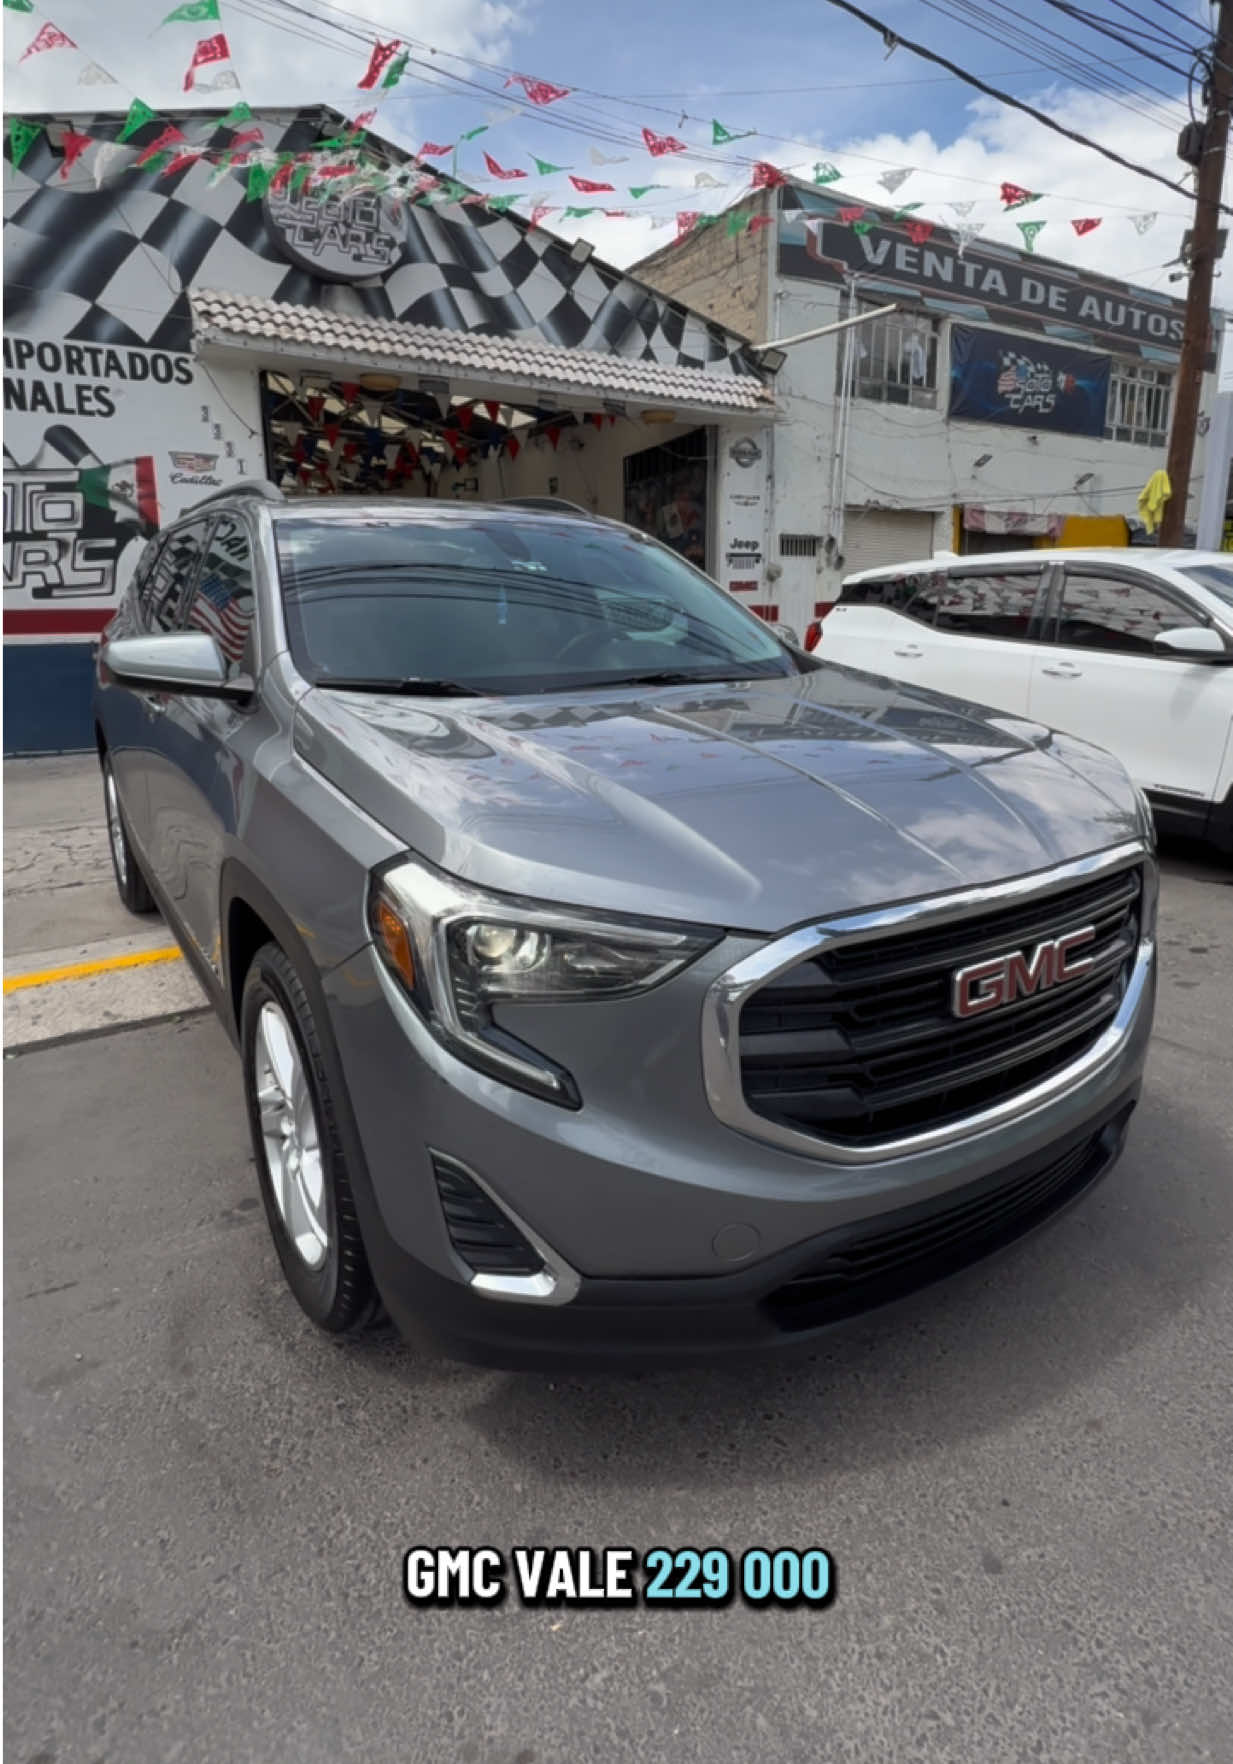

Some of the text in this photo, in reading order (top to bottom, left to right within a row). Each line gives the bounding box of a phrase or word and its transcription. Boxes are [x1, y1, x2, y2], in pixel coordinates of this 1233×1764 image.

[277, 217, 393, 264] CARS
[859, 233, 1185, 341] VENTA DE AUTOS
[1005, 393, 1057, 414] CARS
[3, 467, 85, 534] TO
[729, 537, 760, 552] Jeep
[953, 925, 1096, 1018] GMC
